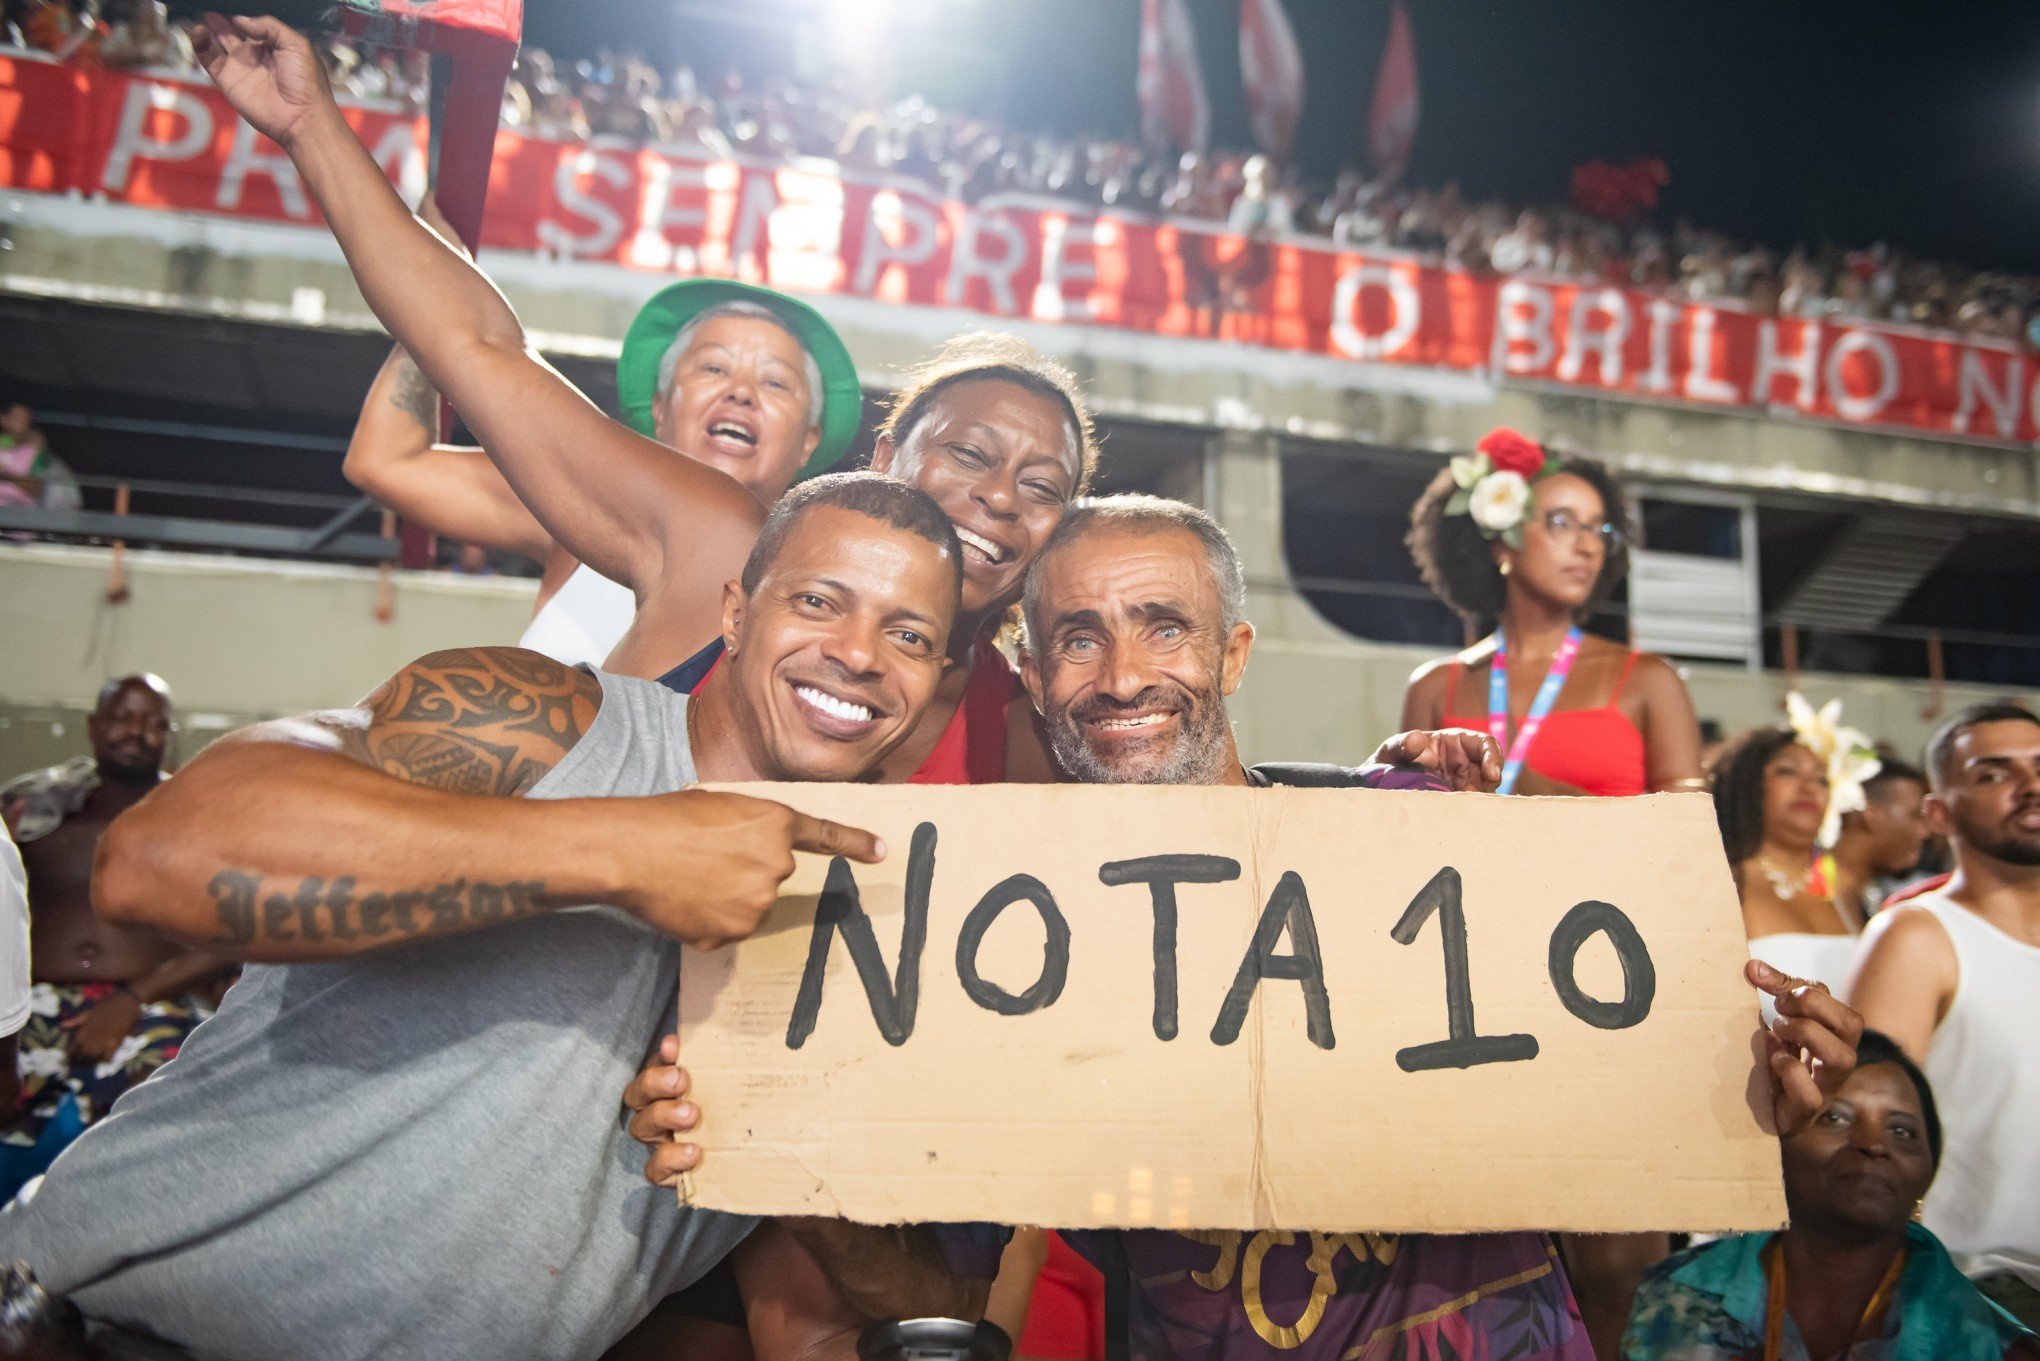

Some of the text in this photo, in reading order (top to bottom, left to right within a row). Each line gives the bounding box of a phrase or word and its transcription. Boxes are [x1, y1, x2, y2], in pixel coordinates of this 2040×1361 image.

[1331, 266, 1420, 359] O
[1490, 281, 1901, 421] BRILHO
[1953, 348, 2040, 440] N
[785, 821, 1656, 1072] NOTA 10
